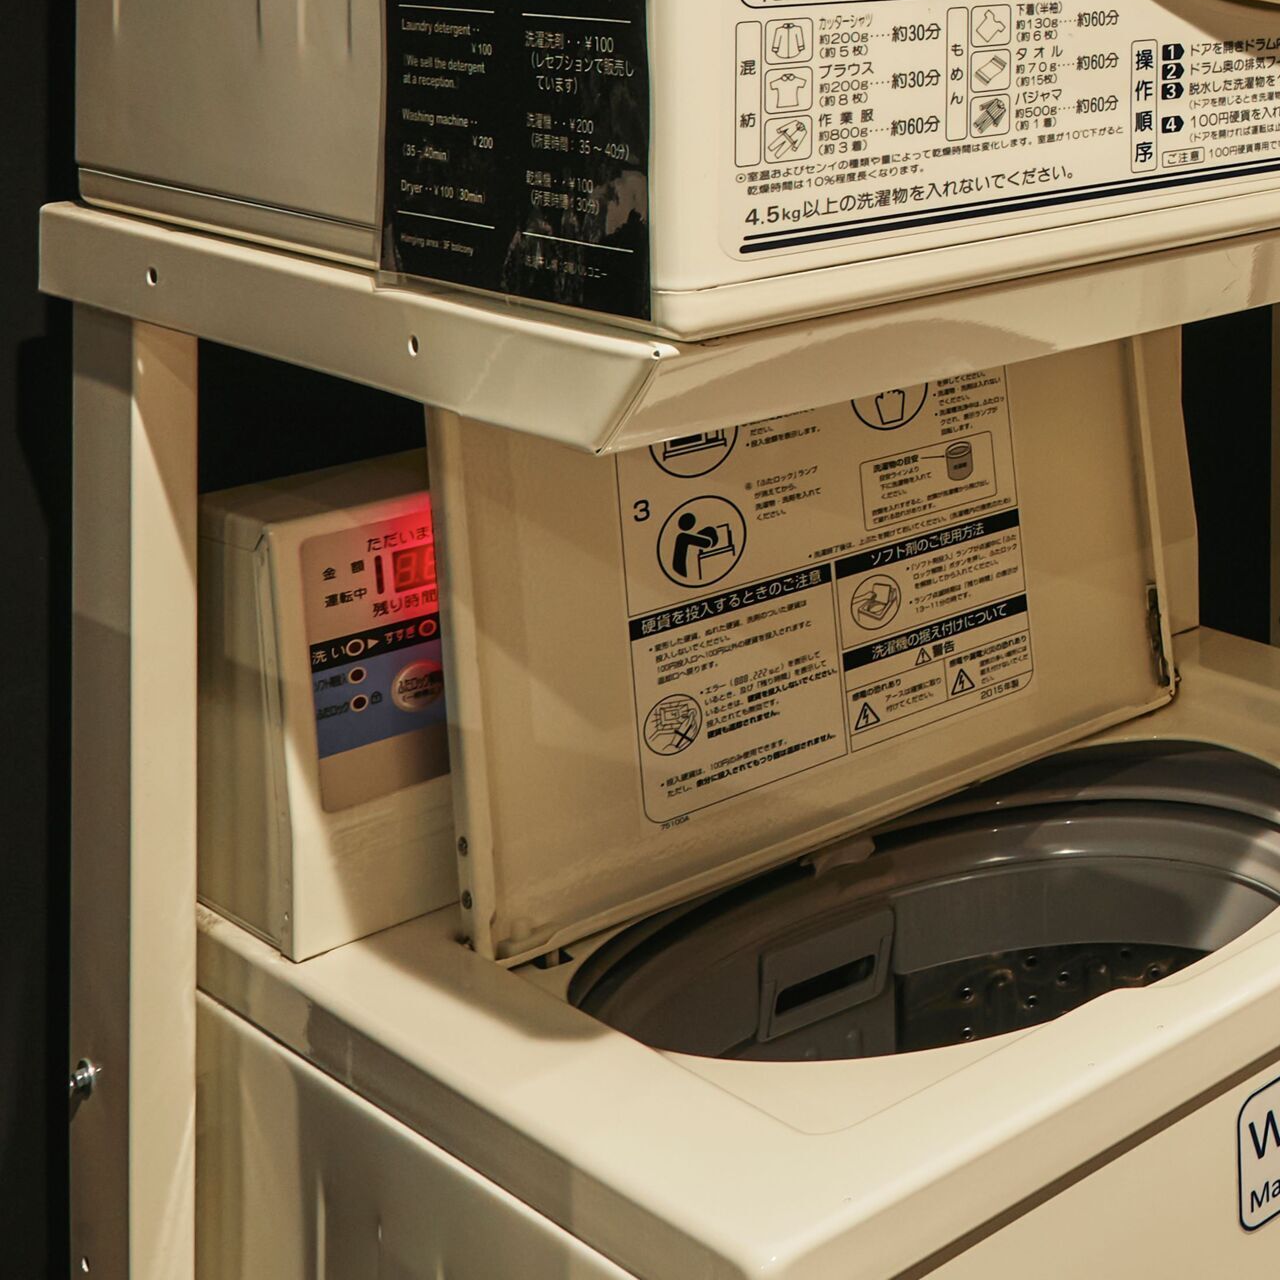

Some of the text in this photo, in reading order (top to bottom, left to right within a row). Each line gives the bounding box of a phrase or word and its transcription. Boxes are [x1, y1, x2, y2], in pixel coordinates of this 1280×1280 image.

[402, 18, 432, 35] Laundry
[1077, 9, 1119, 28] 約60分
[891, 24, 941, 43] 約30分
[818, 62, 874, 78] ブラウス
[891, 70, 941, 90] 約30分
[402, 108, 434, 125] Washing
[891, 116, 940, 137] 約60分
[1167, 150, 1200, 166] ご注意
[401, 180, 423, 195] Dryer
[633, 499, 651, 521] 3
[871, 523, 984, 566] ソフト剤のご使用方法
[641, 569, 821, 634] 硬貨を投入するときのご注意
